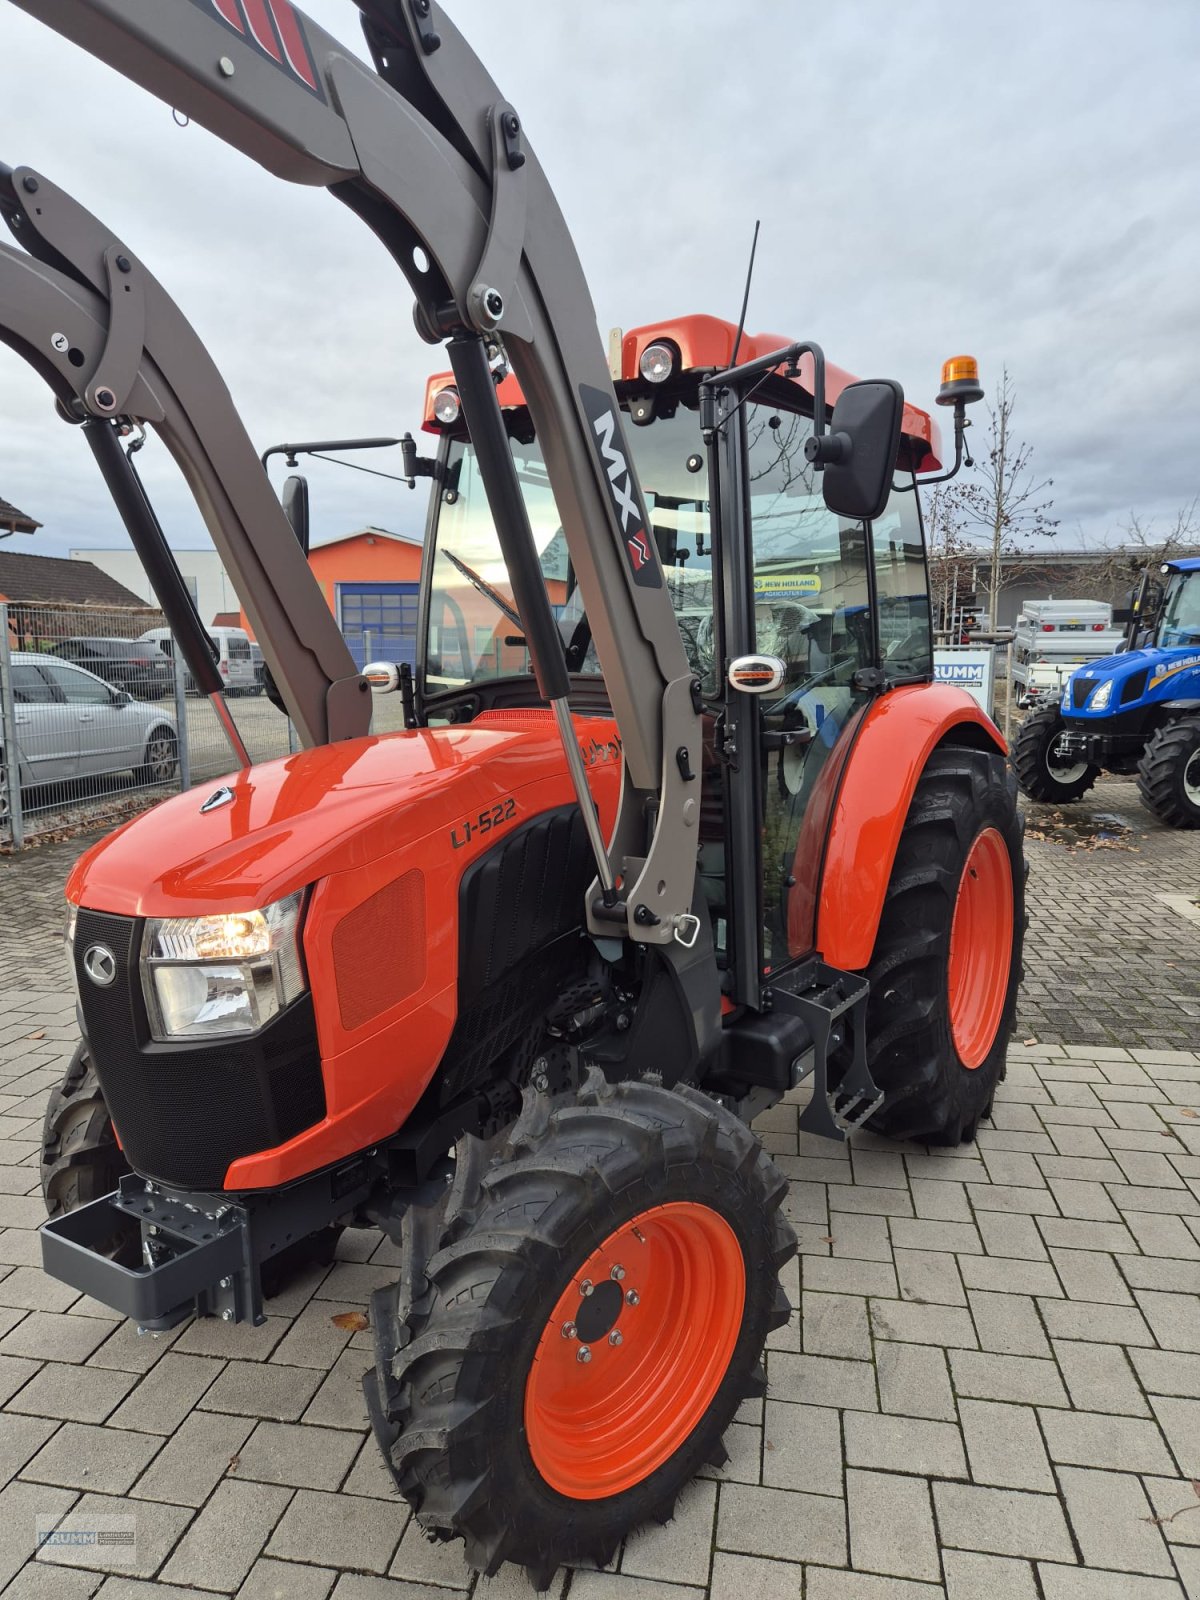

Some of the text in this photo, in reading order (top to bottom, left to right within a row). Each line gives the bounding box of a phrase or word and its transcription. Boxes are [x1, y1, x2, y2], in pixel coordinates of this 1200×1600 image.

[593, 410, 641, 533] MX
[765, 580, 780, 588] NEW
[934, 665, 983, 679] RUMM
